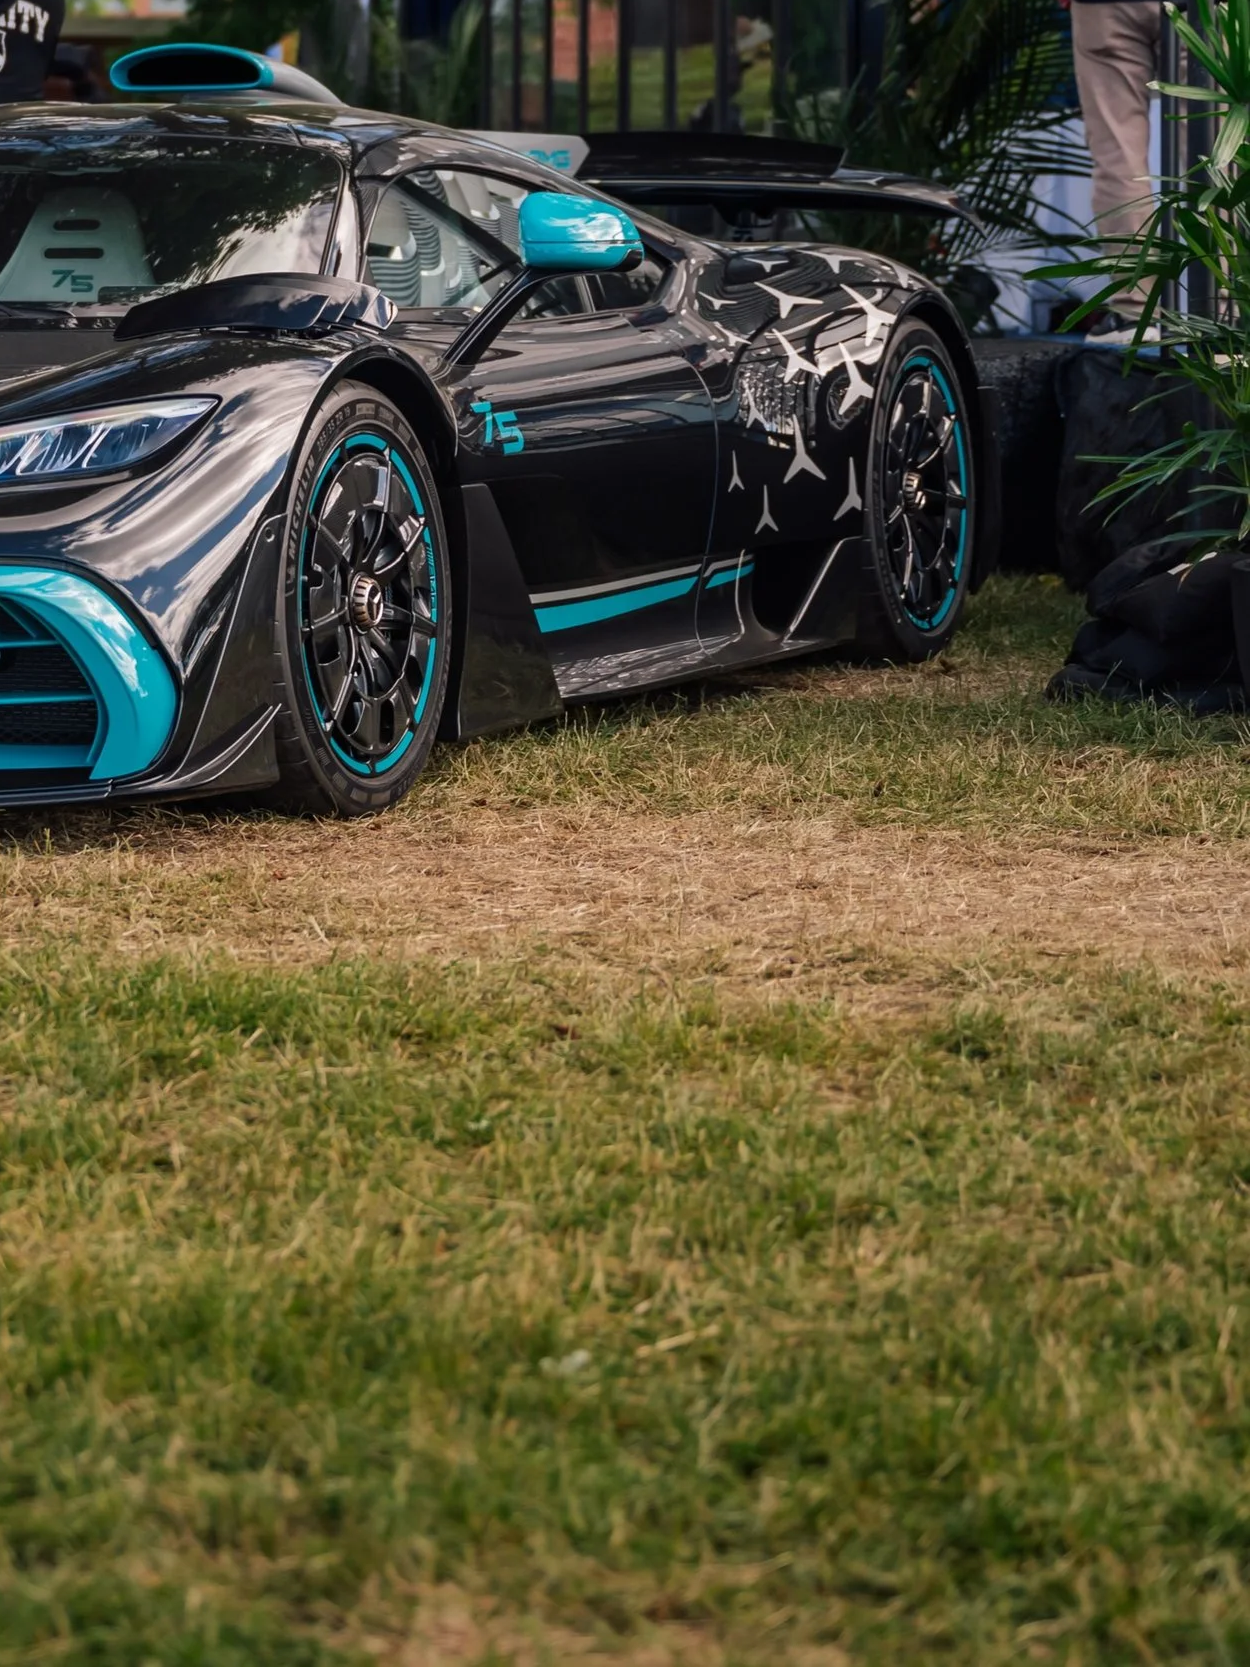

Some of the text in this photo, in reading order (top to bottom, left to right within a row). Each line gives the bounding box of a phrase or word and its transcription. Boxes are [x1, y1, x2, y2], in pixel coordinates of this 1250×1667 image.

[522, 148, 571, 169] MG
[52, 269, 94, 293] 75
[470, 401, 524, 454] 75
[288, 455, 315, 560] MICHELIN
